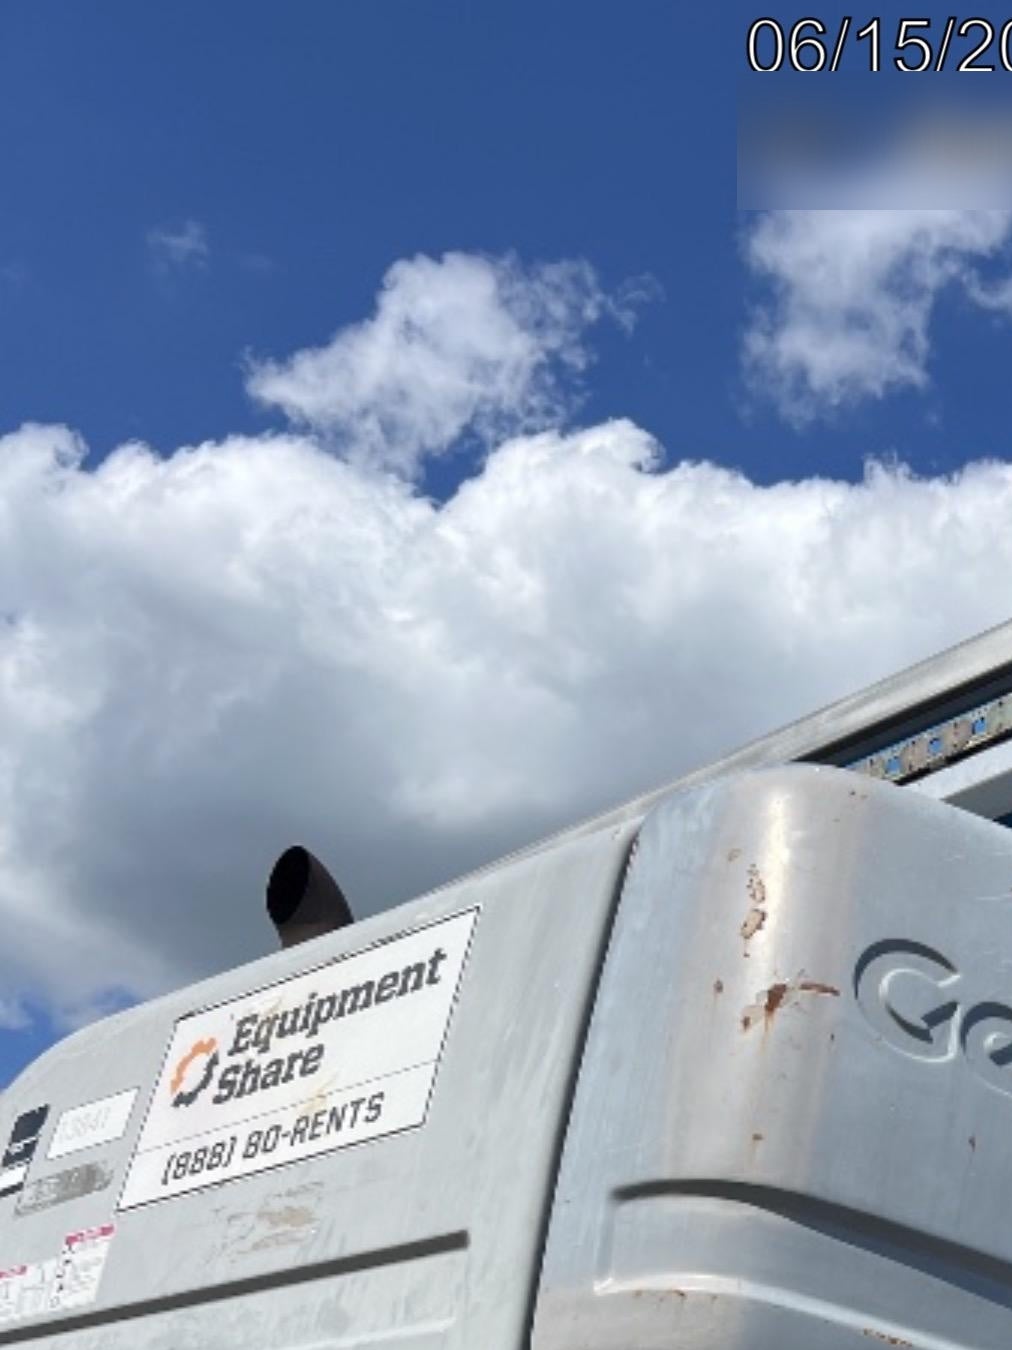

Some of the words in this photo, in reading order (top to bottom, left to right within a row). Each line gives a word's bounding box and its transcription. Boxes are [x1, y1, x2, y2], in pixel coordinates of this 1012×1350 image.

[227, 948, 447, 1056] Equipment
[212, 1043, 324, 1104] Share
[161, 1137, 236, 1186] (888)
